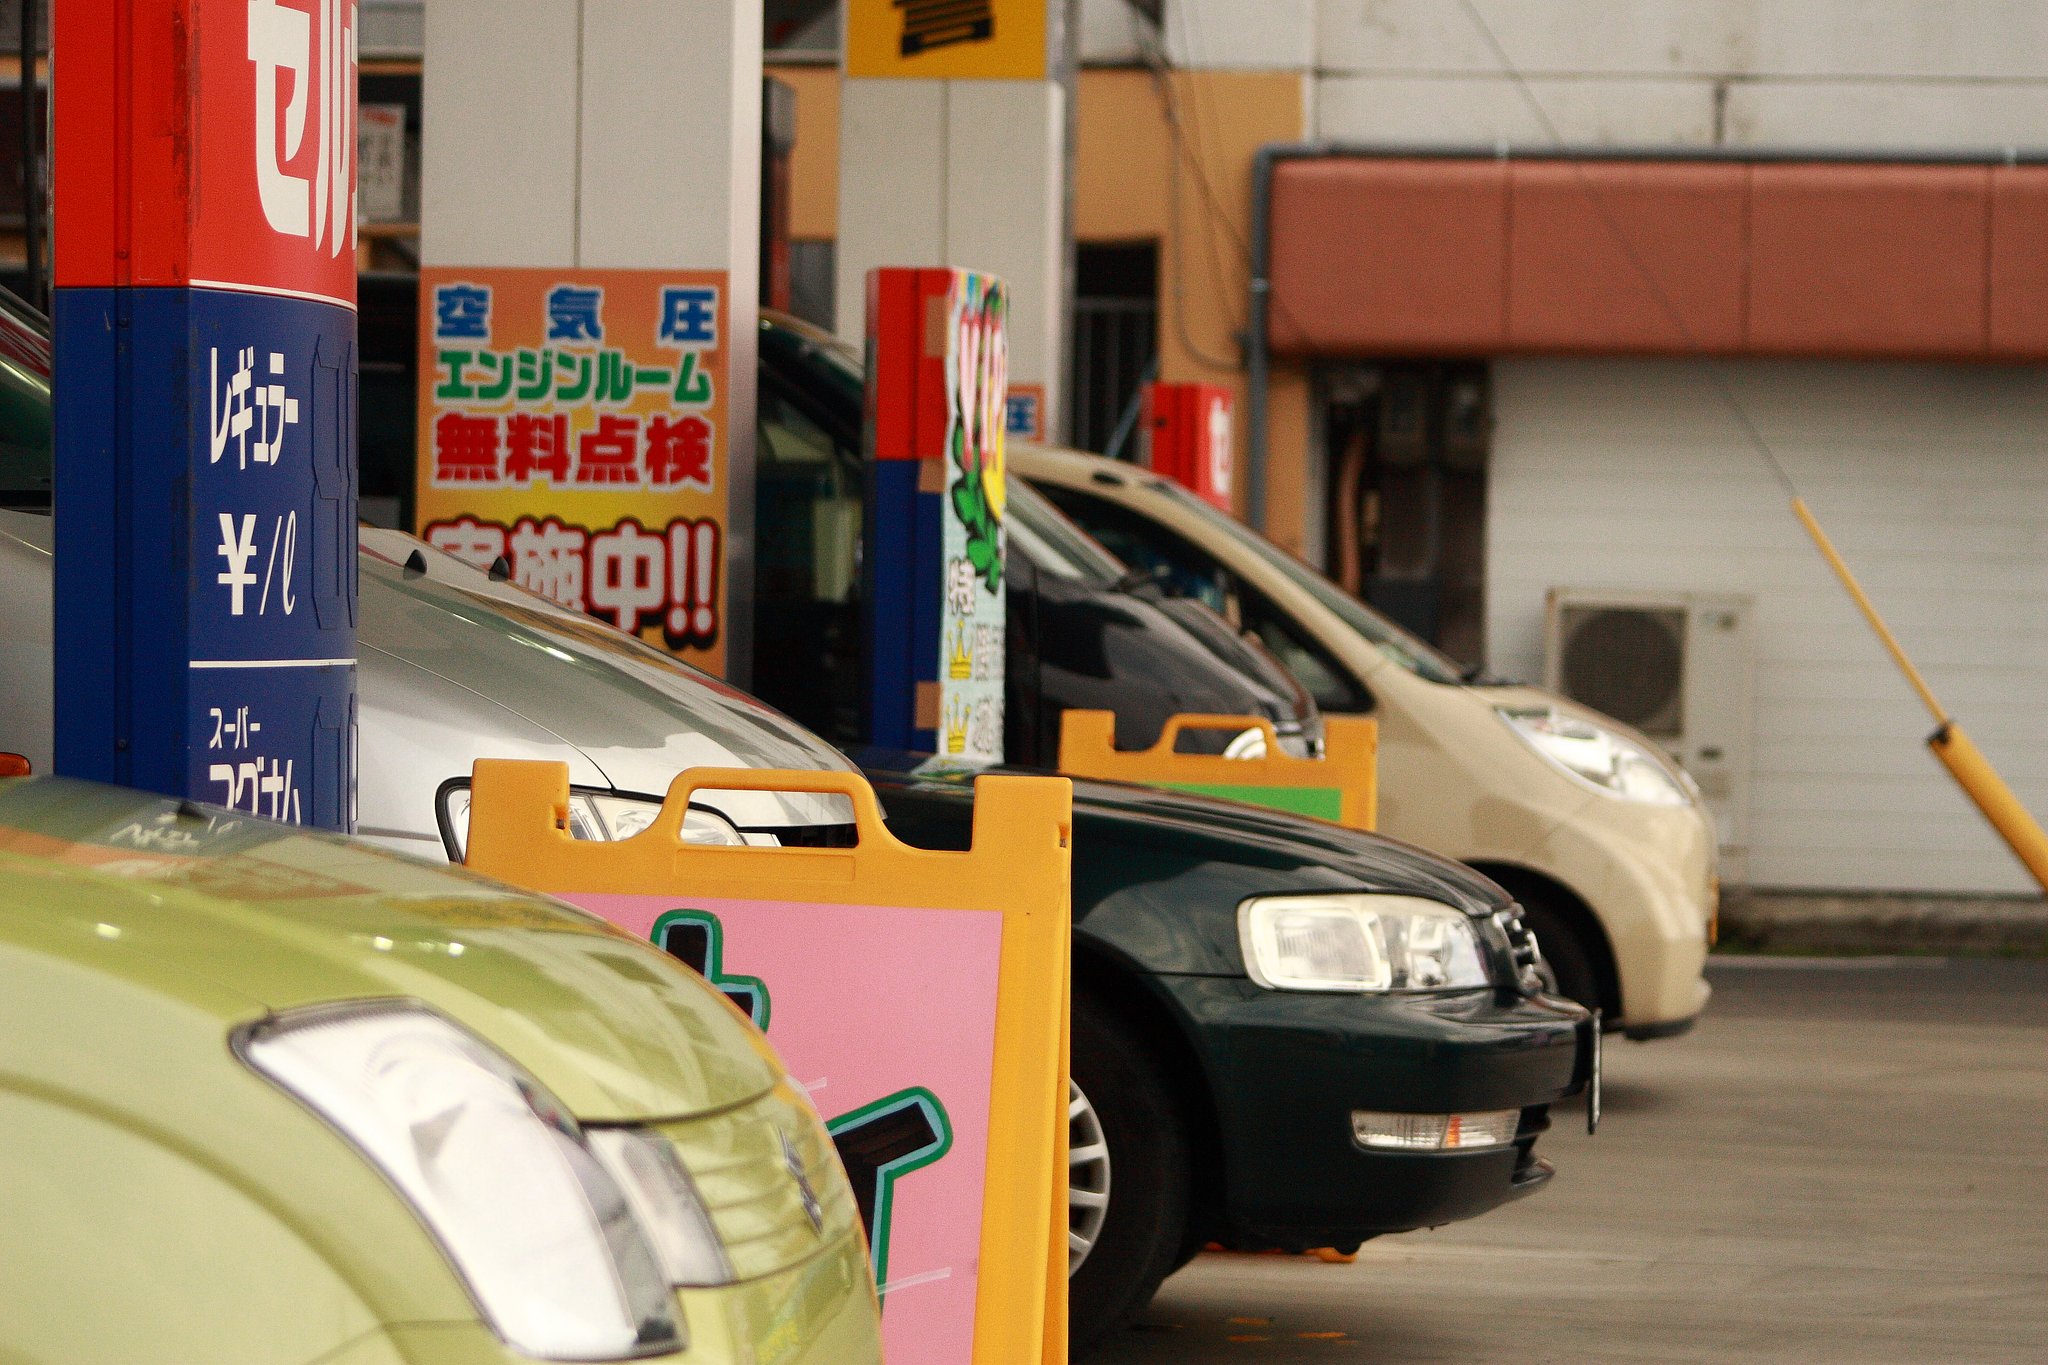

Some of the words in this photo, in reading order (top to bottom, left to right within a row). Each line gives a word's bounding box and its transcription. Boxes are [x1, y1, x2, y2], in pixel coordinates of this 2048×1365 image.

[211, 346, 299, 470] レギュラー
[436, 349, 712, 403] エンジンルーム
[434, 411, 713, 485] 無料点検
[209, 705, 261, 749] スーパー
